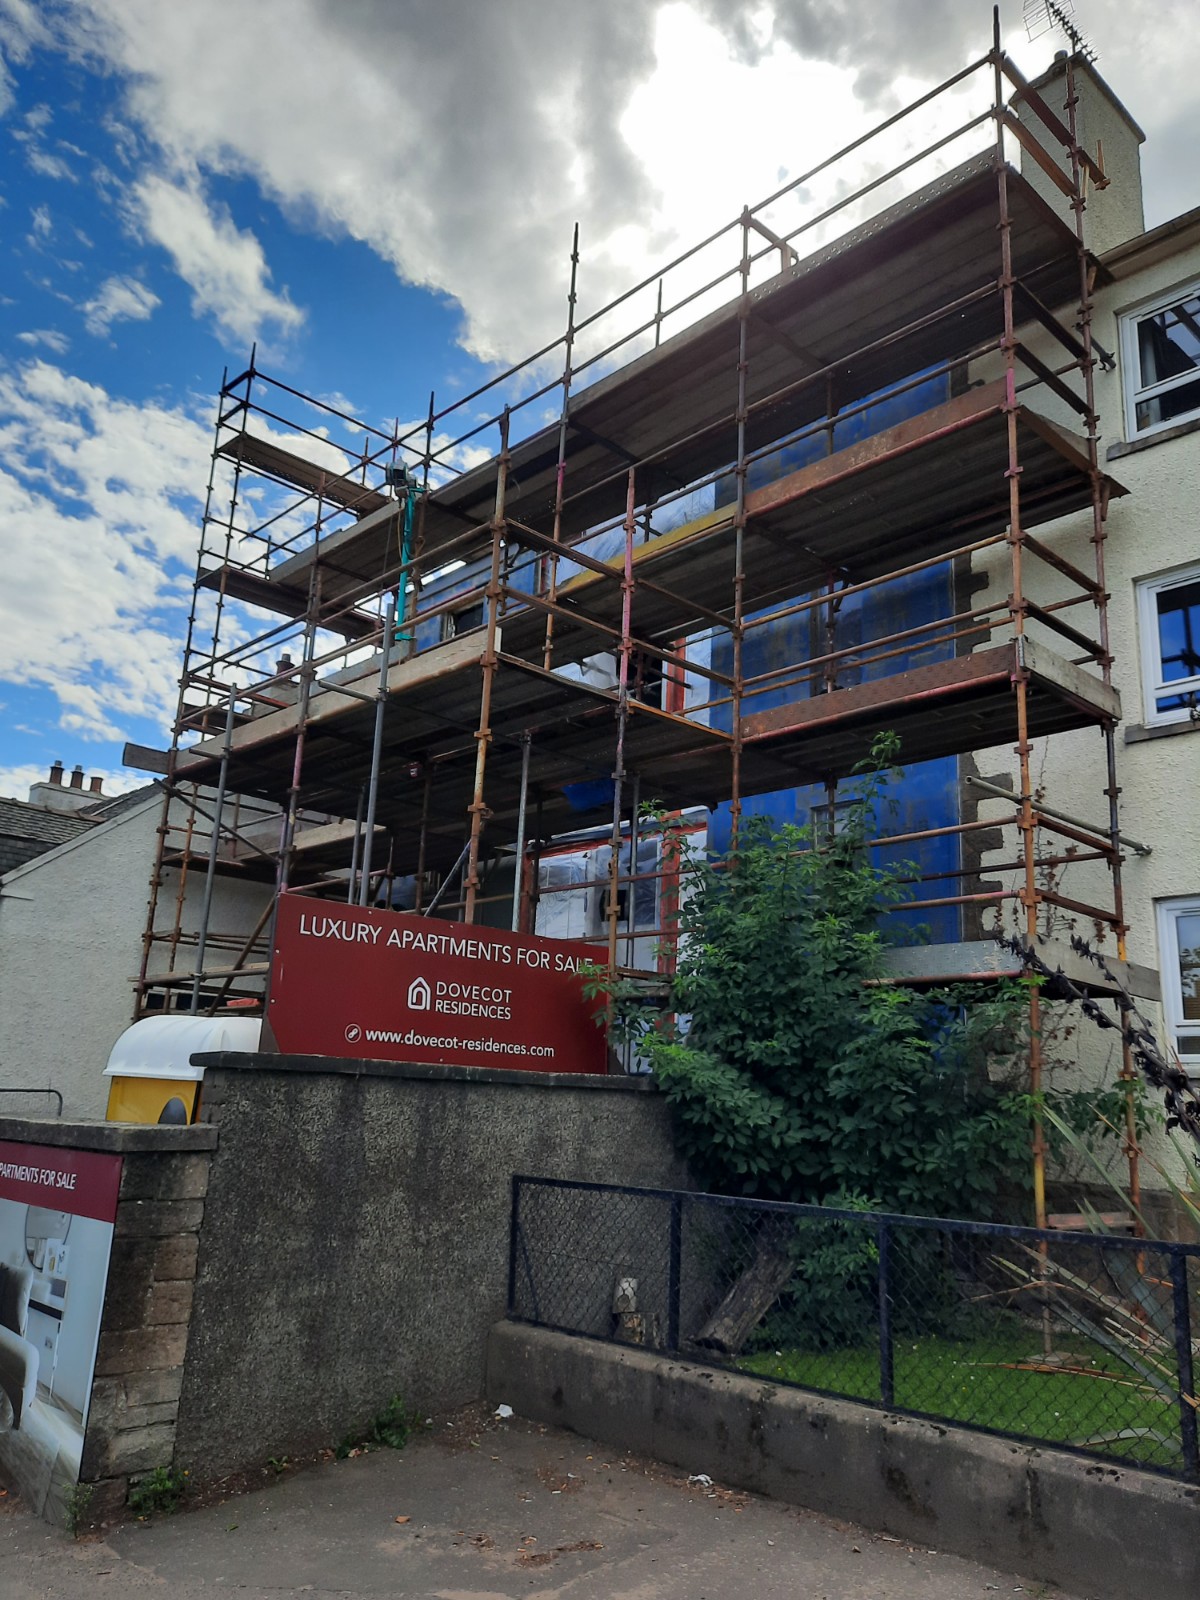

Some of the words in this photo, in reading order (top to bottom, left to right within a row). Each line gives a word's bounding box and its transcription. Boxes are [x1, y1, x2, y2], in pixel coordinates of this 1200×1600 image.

[299, 914, 382, 945] LUXURY
[386, 928, 512, 964] APARTMENTS
[516, 947, 550, 970] FOR
[436, 981, 512, 1003] DOVECOT
[435, 999, 512, 1020] RESIDENCES
[365, 1029, 555, 1057] www.dovecot-residences.com
[39, 1169, 55, 1187] FOR
[56, 1171, 77, 1190] SALE
